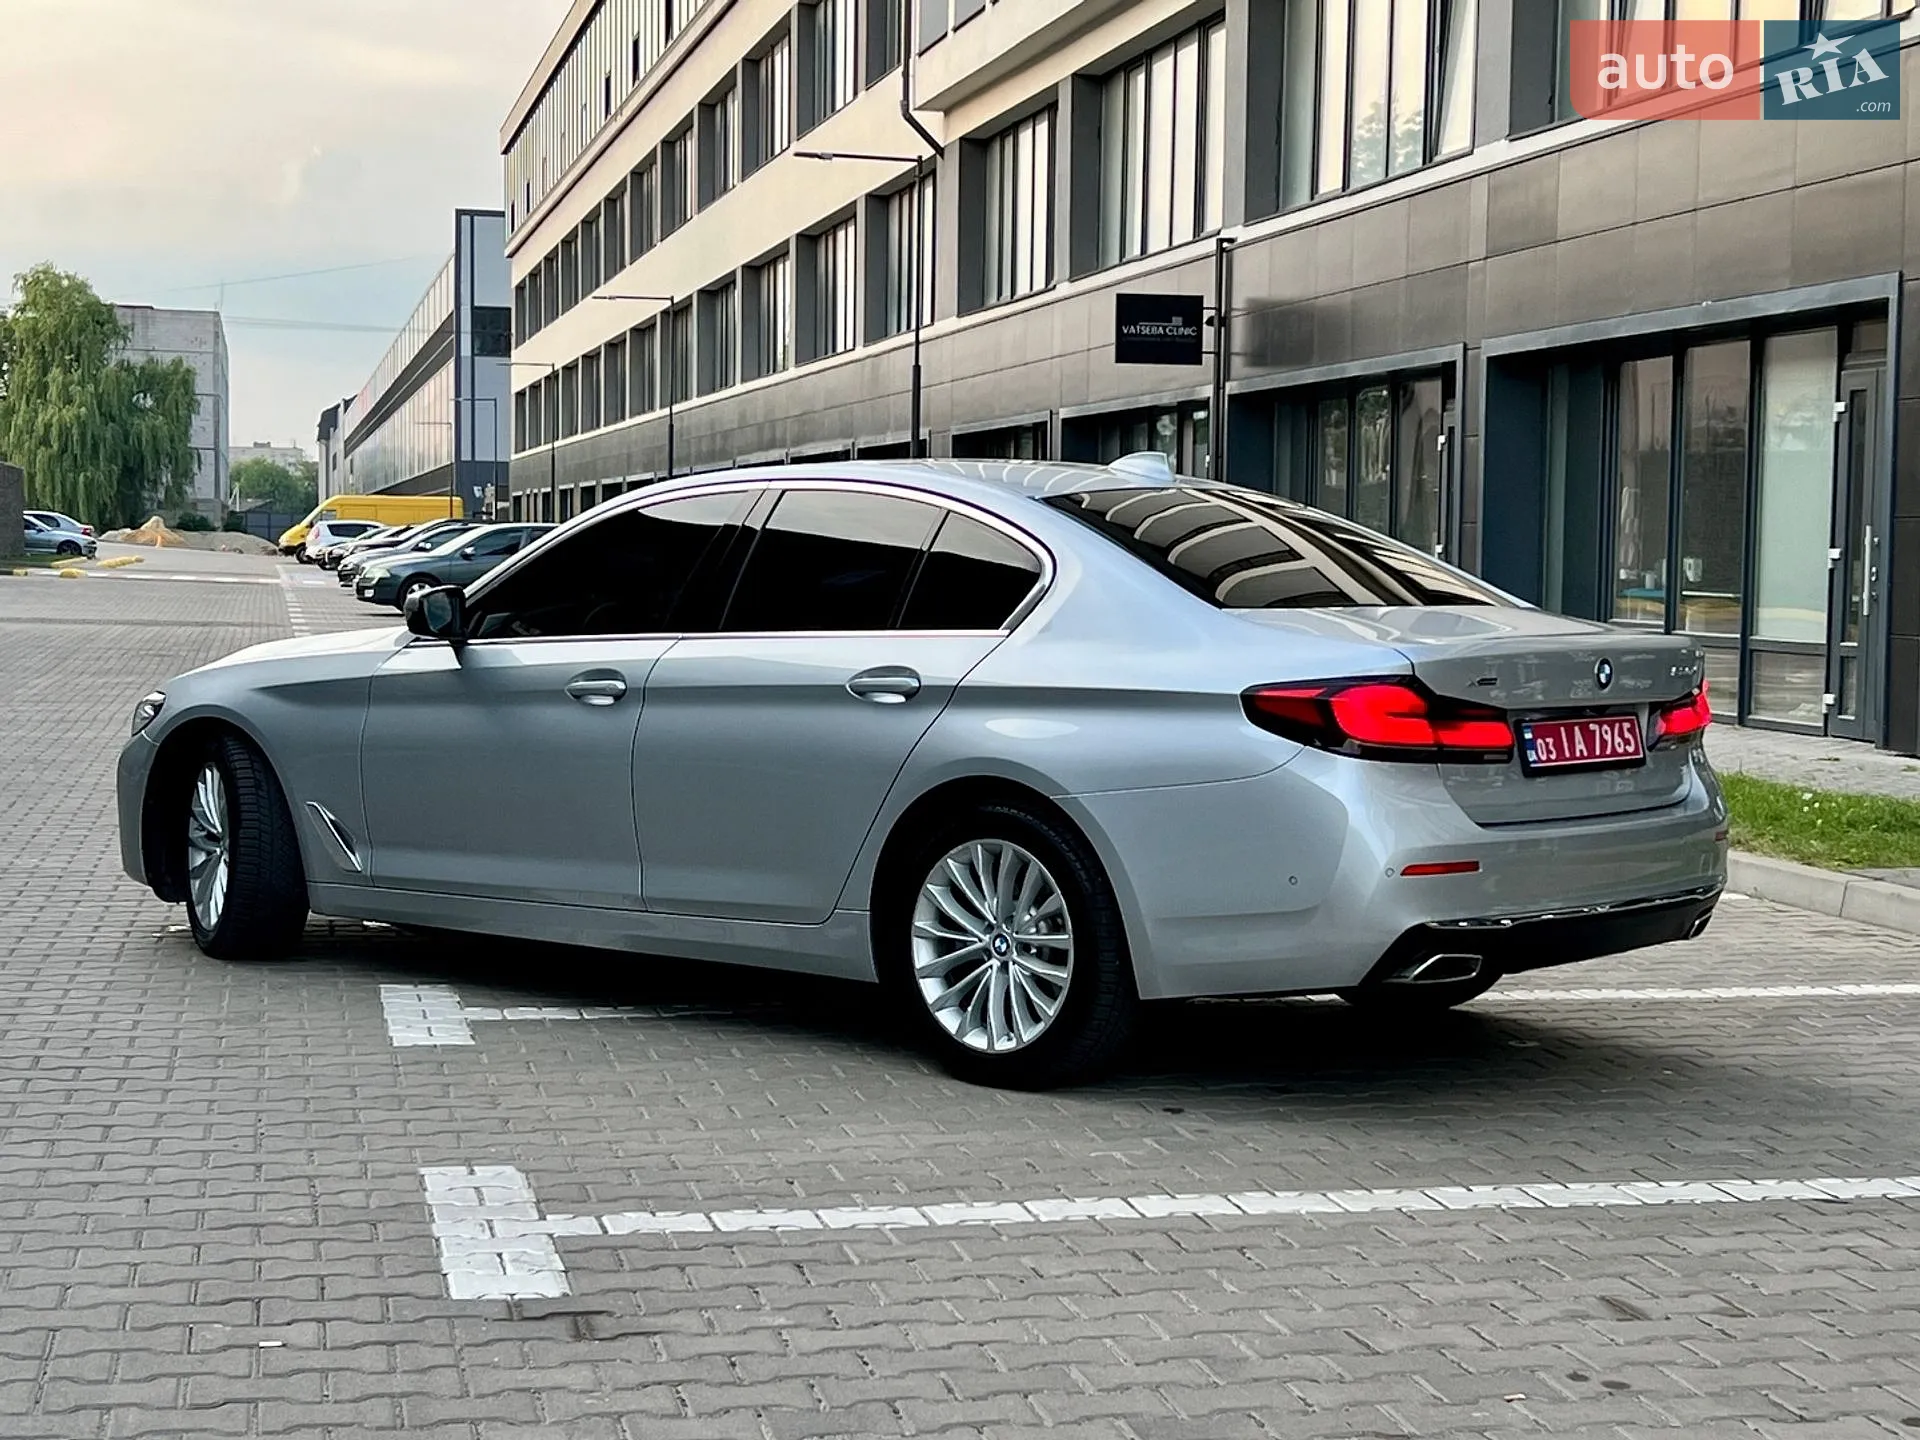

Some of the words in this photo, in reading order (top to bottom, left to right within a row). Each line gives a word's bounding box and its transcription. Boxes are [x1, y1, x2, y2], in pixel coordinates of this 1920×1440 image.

[1536, 737, 1557, 761] 03
[1560, 725, 1588, 758] IA
[1589, 721, 1636, 756] 7965
